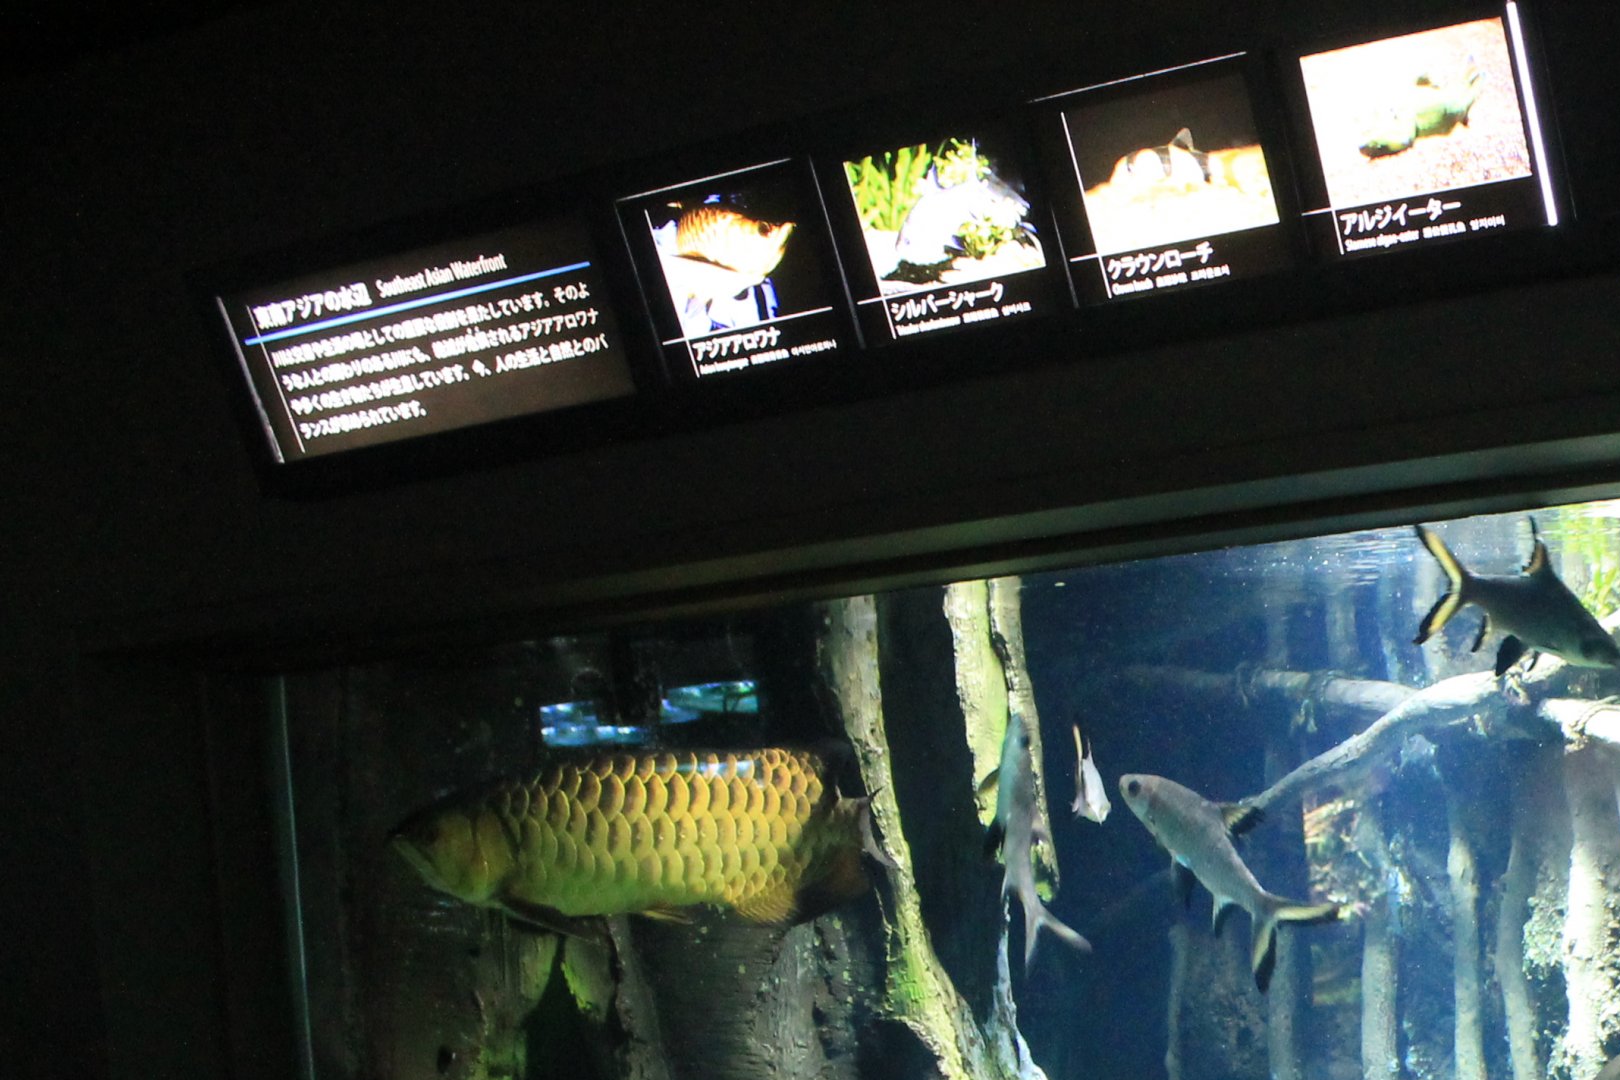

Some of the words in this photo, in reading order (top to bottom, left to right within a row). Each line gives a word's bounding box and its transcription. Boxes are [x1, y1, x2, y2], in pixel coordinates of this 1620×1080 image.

[1339, 198, 1462, 236] アルジイーター
[424, 262, 456, 289] Asian
[449, 252, 508, 283] Waterfront
[1107, 240, 1214, 281] クラウンローチ
[890, 281, 1004, 322] シルバーシャーク
[692, 326, 782, 362] アジアアロワナ
